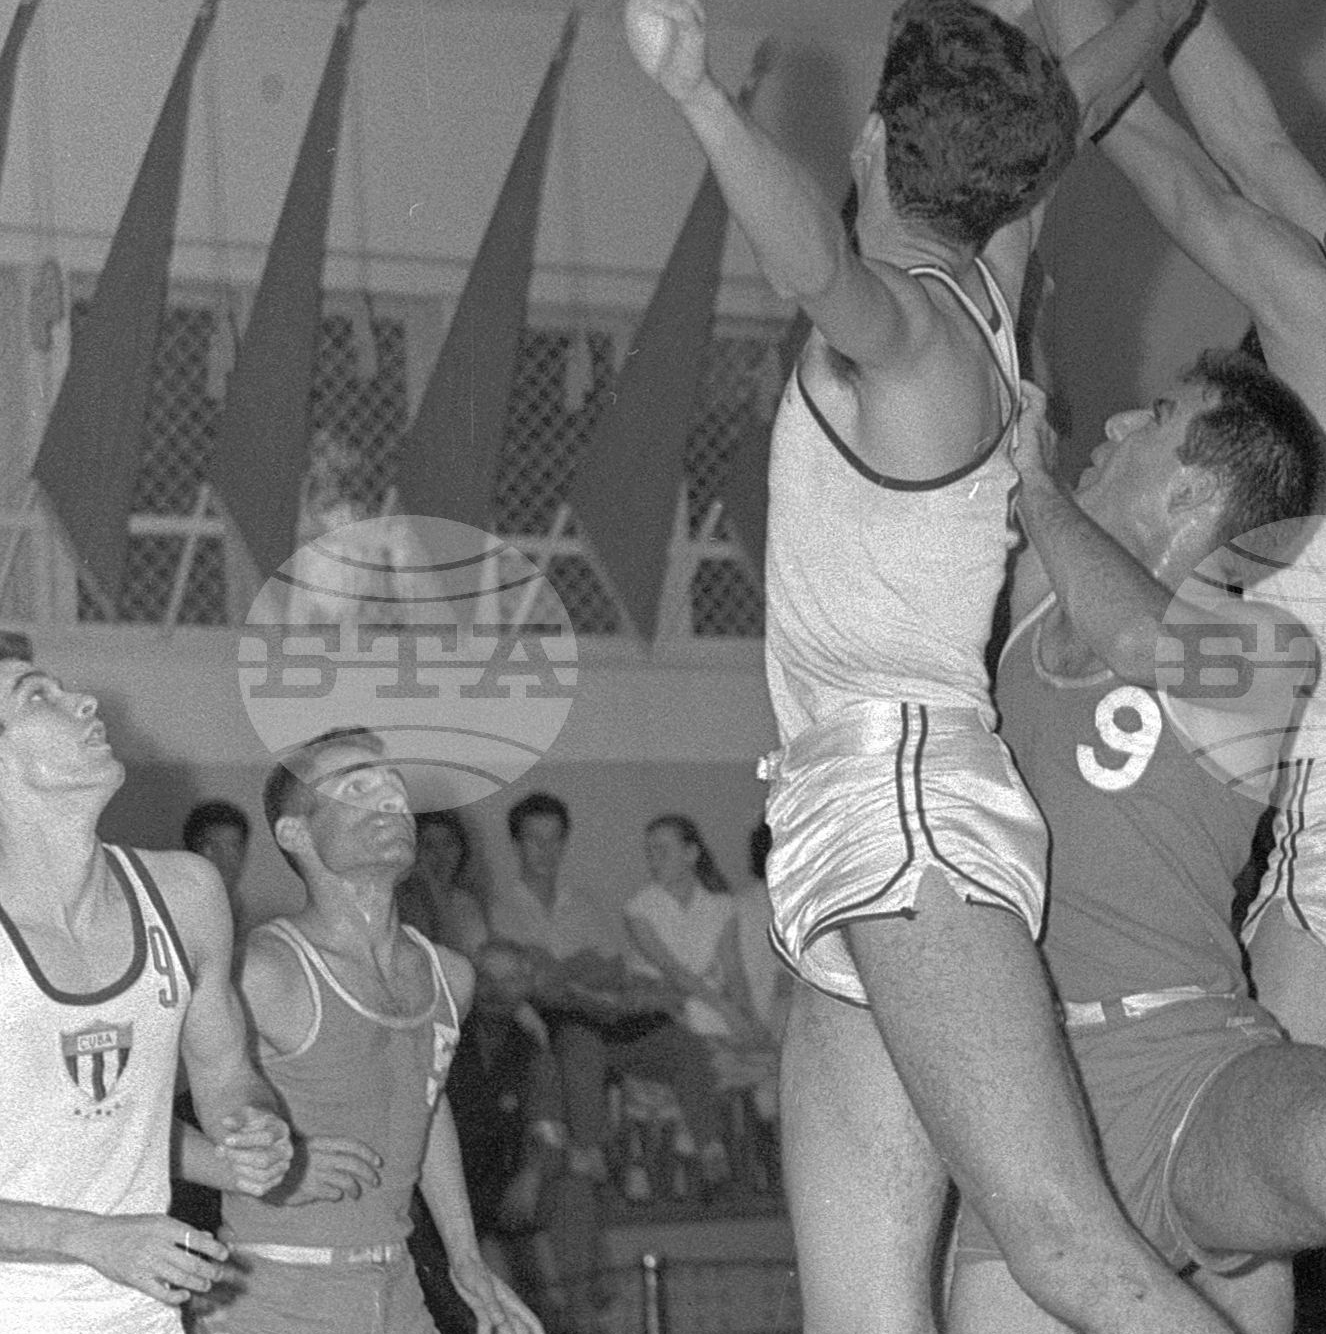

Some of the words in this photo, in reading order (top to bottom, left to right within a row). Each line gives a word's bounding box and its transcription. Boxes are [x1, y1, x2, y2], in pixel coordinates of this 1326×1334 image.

[1076, 686, 1162, 791] 9
[148, 926, 178, 1008] 9
[79, 1033, 113, 1051] CUBA
